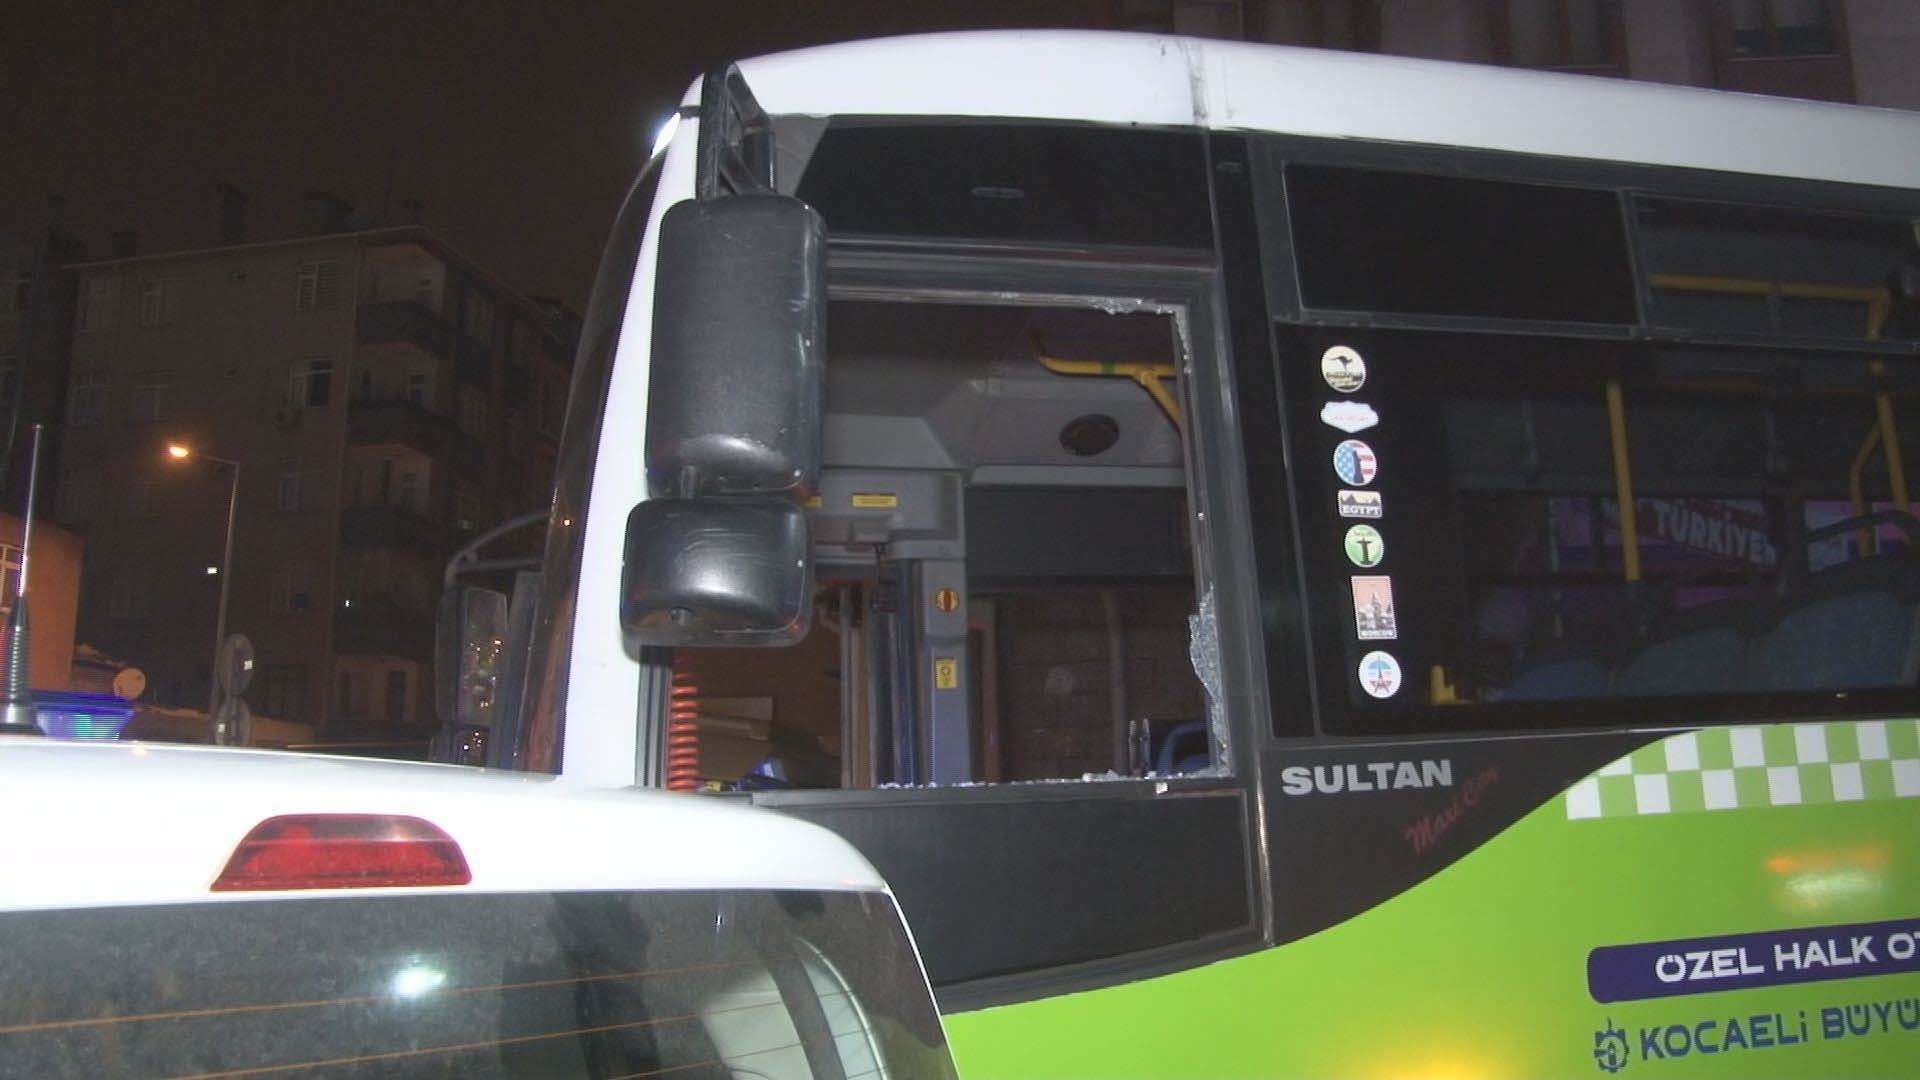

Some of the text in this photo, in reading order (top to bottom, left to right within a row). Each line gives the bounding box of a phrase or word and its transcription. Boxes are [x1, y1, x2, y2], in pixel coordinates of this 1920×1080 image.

[1343, 504, 1380, 516] EGYPT
[1281, 759, 1453, 795] SULTAN
[1655, 947, 1764, 983] ÖZEL
[1774, 935, 1877, 971] HALK
